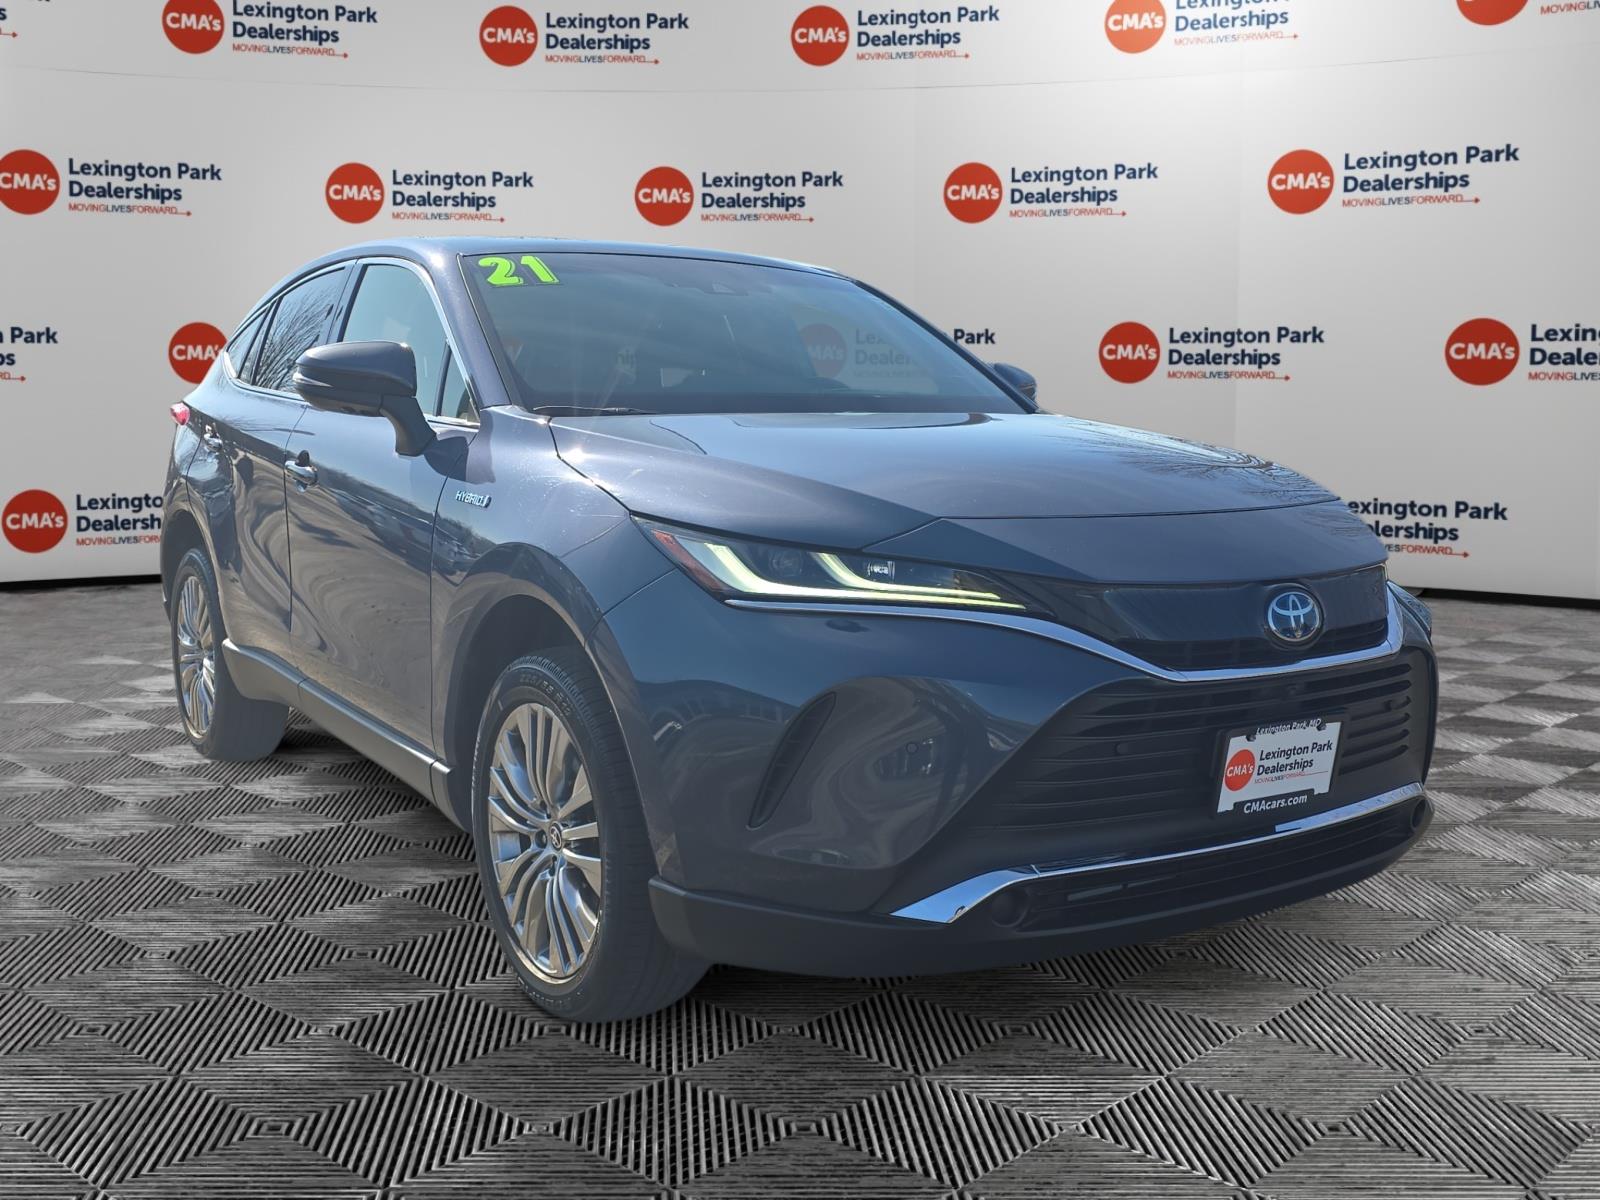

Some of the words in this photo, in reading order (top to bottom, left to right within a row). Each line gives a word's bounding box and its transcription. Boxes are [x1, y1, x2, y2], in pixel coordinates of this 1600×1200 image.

[233, 0, 329, 23] Lexington
[335, 5, 378, 23] Park
[857, 10, 951, 29] Lexington
[957, 5, 1000, 22] Park
[1108, 11, 1164, 31] CMA's
[1175, 10, 1288, 32] Dealerships
[166, 12, 222, 31] CMA's
[546, 12, 640, 33] Lexington
[647, 13, 689, 29] Park
[232, 21, 339, 45] Dealerships
[483, 27, 535, 44] CMA's
[794, 27, 847, 44] CMA's
[857, 29, 961, 49] Dealerships
[232, 43, 336, 56] MOVINGLIVESFORWARD
[546, 33, 650, 53] Dealerships
[545, 55, 647, 63] MOVINGLIVESFORWARD
[857, 50, 958, 61] MOVINGLIVESFORWARD
[1344, 150, 1458, 172] Lexington
[1465, 143, 1519, 164] Park
[68, 158, 171, 181] Lexington
[178, 163, 222, 181] Park
[1011, 166, 1108, 186] Lexington
[1114, 162, 1158, 180] Park
[0, 172, 56, 191] CMA's
[392, 169, 486, 190] Lexington
[492, 171, 534, 188] Park
[701, 172, 796, 192] Lexington
[802, 171, 844, 187] Park
[1271, 171, 1331, 191] CMA's
[1343, 170, 1470, 193] Dealerships
[68, 180, 182, 204] Dealerships
[328, 183, 382, 201] CMA's
[392, 190, 496, 211] Dealerships
[638, 187, 691, 204] CMA's
[947, 183, 1000, 201] CMA's
[1010, 186, 1118, 206] Dealerships
[1342, 194, 1463, 208] MOVINGLIVESFORWARD
[68, 203, 178, 215] MOVINGLIVESFORWARD
[701, 193, 806, 212] Dealerships
[392, 212, 492, 221] MOVINGLIVESFORWARD
[701, 213, 801, 222] MOVINGLIVESFORWARD
[1010, 207, 1113, 218] MOVINGLIVESFORWARD
[478, 255, 559, 285] 21
[10, 326, 58, 344] Park
[953, 328, 996, 345] Park
[1169, 327, 1270, 347] Lexington
[1277, 326, 1324, 343] Park
[172, 344, 219, 361] CMA'
[1102, 343, 1157, 361] CMA's
[1168, 349, 1280, 369] Dealerships
[1449, 342, 1515, 360] CMA's
[1529, 347, 1600, 366] Deale
[1167, 371, 1275, 380] MOVINGLIVESFORWARD
[455, 490, 484, 507] HYBRID
[1455, 500, 1508, 520] Park
[5, 512, 64, 529] CMA's
[1256, 724, 1291, 735] Lexington
[1259, 745, 1309, 762] Lexington
[1311, 740, 1333, 753] Park
[1227, 764, 1254, 777] CMA's
[1256, 759, 1313, 776] Dealerships
[1243, 794, 1308, 813] CMAcars.com
